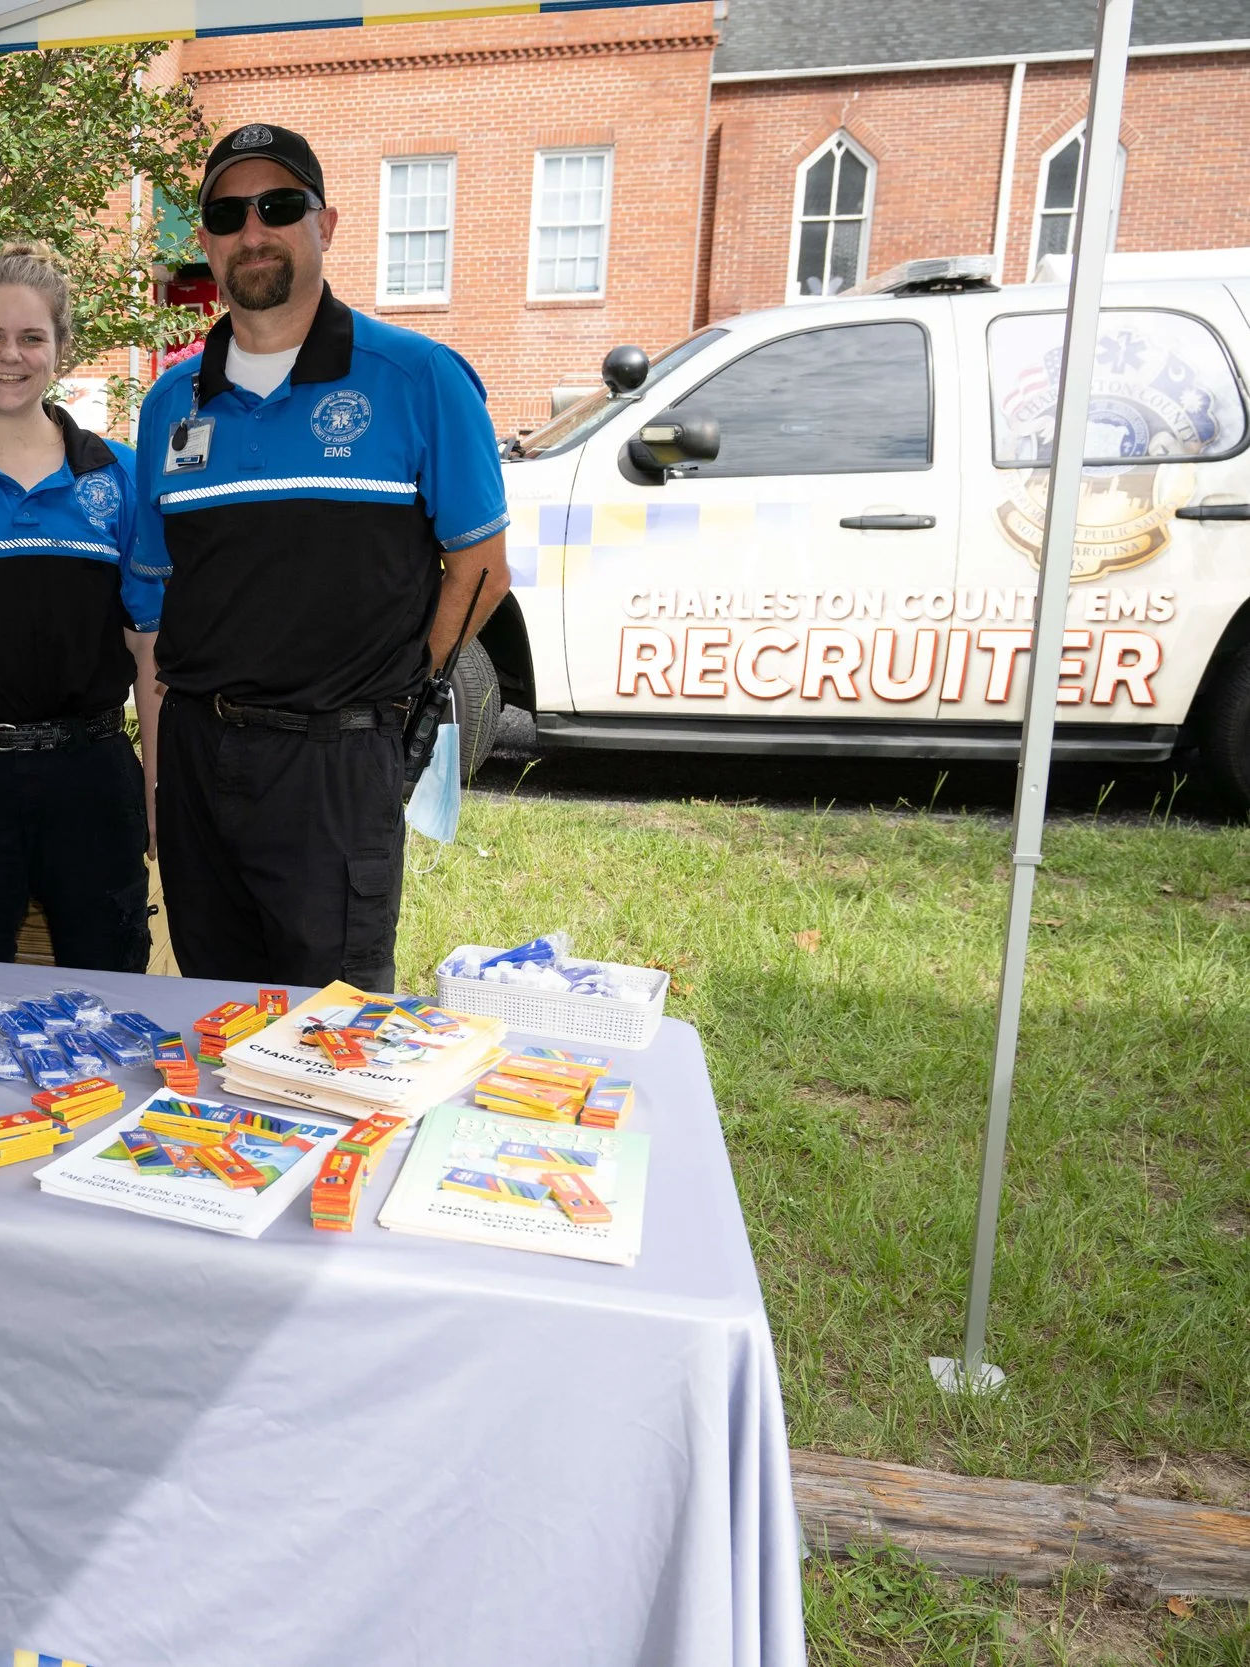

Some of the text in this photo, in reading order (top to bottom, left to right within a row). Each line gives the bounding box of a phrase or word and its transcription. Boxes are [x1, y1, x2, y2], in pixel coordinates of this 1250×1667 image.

[1139, 389, 1196, 442] COUNTY
[323, 446, 352, 458] EMS
[1073, 541, 1140, 557] AROLINA
[623, 585, 885, 621] CHARLESTON
[1084, 586, 1176, 623] EMS
[616, 625, 1164, 707] RECRUITER
[305, 1066, 337, 1077] EMS
[350, 1069, 418, 1084] COUNTY
[298, 1123, 338, 1138] UP
[457, 1116, 623, 1148] BICYCLE
[59, 1170, 246, 1221] EMERGENCY MEDICAL SERVICE
[91, 1173, 225, 1209] CHARLESTON COUNTY
[427, 1207, 610, 1239] EMERGENCY MEDICAL
[429, 1202, 611, 1233] CHARLESTON COUNTY
[481, 1222, 551, 1236] SERVICE
